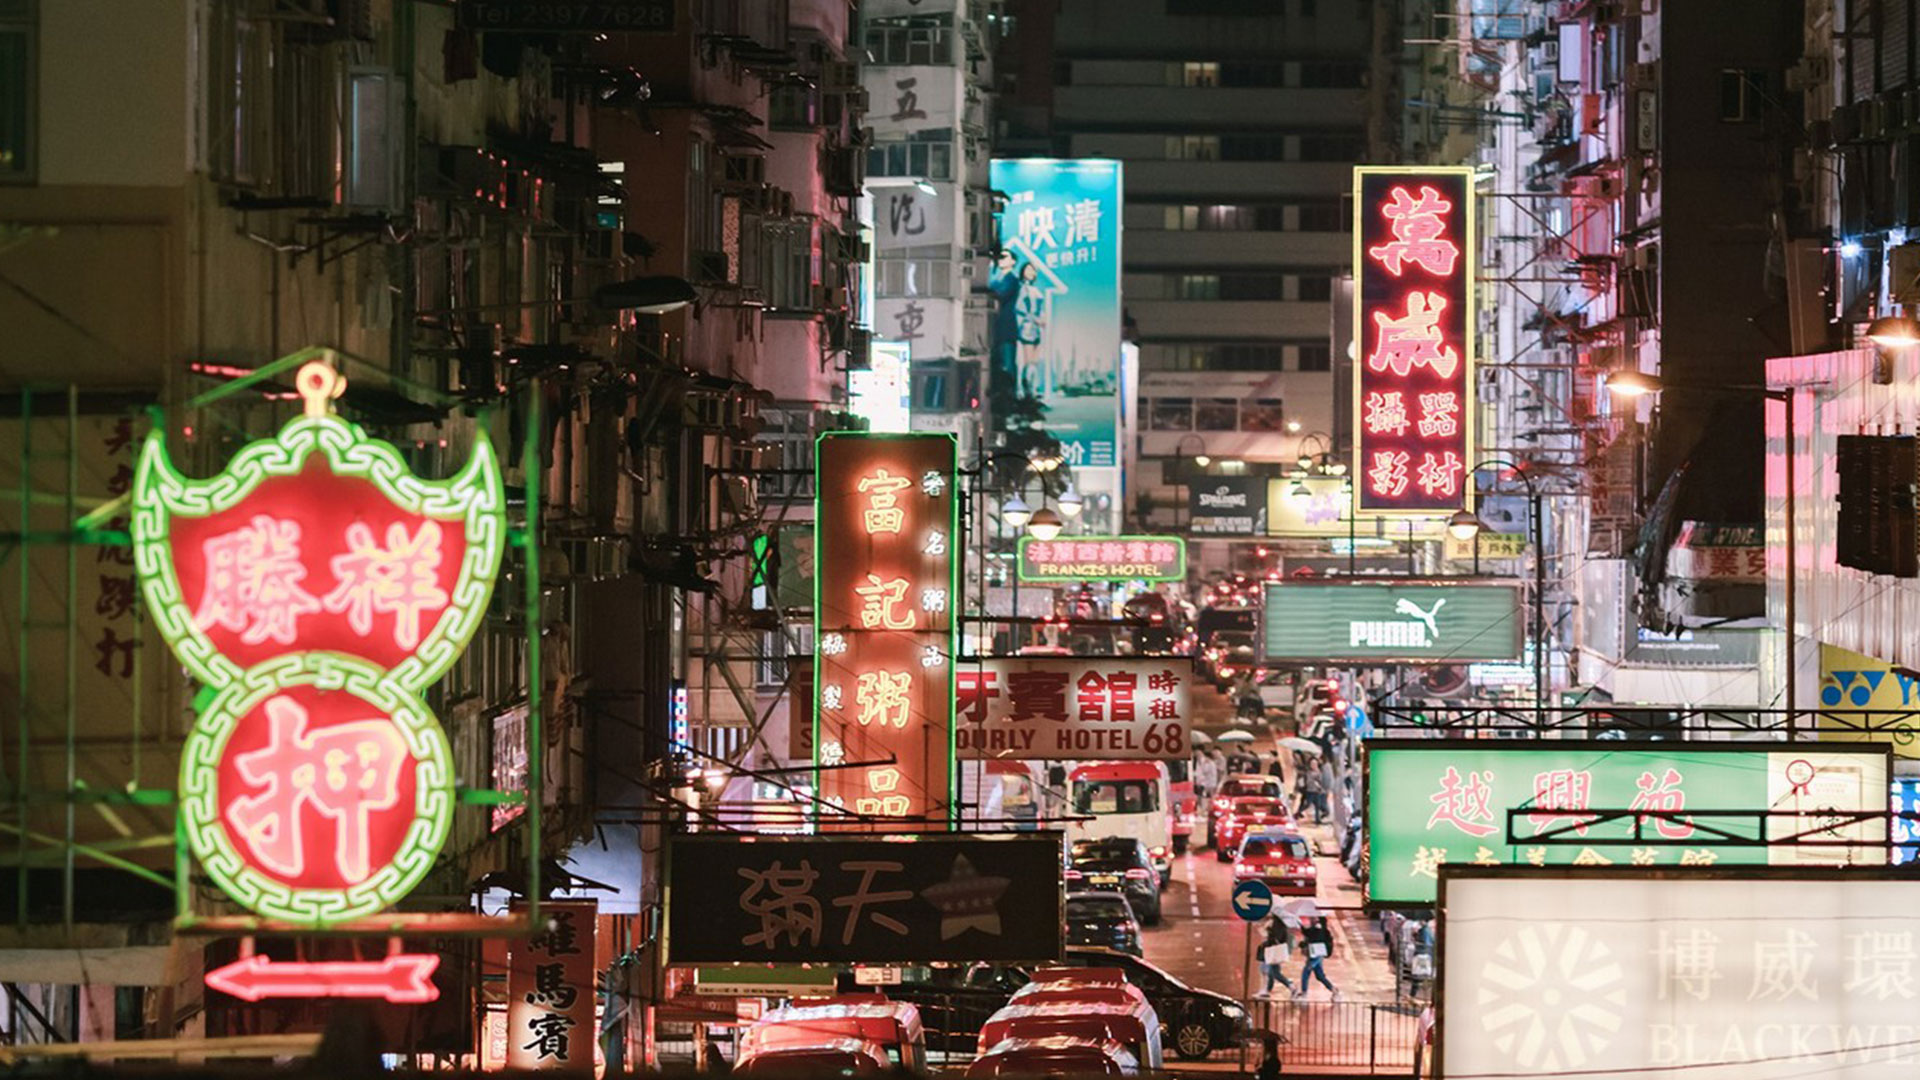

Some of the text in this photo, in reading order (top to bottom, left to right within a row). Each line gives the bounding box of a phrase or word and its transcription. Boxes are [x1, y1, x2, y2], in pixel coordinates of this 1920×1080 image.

[521, 4, 590, 24] 2397
[596, 5, 665, 26] 7628
[1039, 563, 1162, 576] FRANCIS HOTEL
[856, 469, 916, 817] 富記粥品
[1148, 669, 1181, 720] 時租
[956, 728, 1138, 750] OURLY HOTEL
[1143, 723, 1183, 754] 68
[227, 695, 410, 883] 押
[522, 910, 582, 1066] 羅馬賓
[1647, 927, 1918, 1002] 博威環
[1647, 1023, 1920, 1066] BLACKWE
